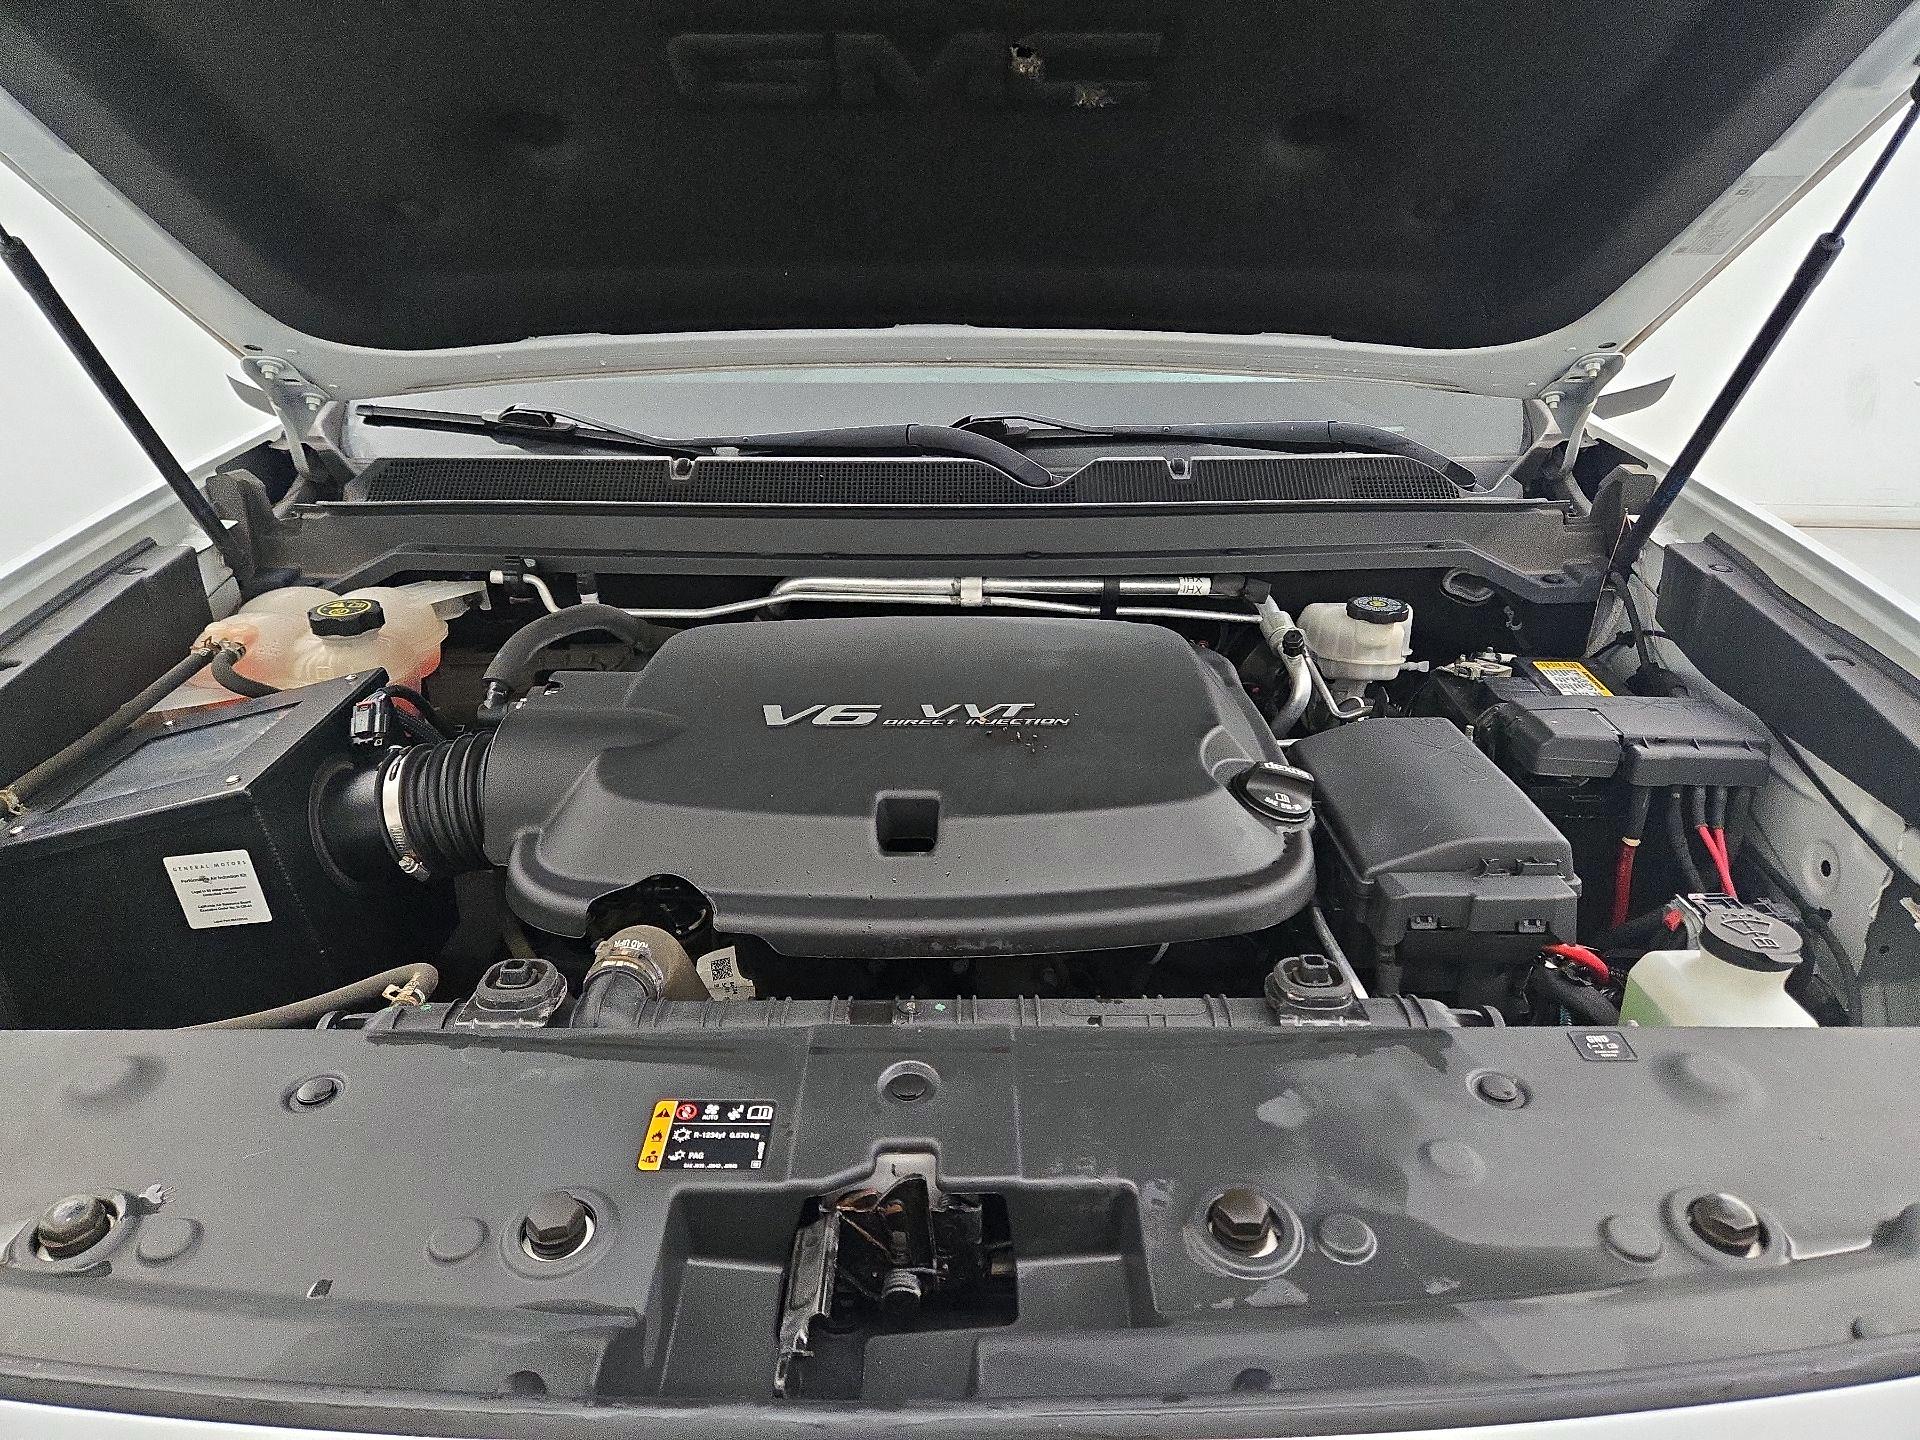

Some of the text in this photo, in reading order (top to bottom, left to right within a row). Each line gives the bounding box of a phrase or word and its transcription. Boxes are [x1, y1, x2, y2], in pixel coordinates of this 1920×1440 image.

[667, 32, 1163, 108] GMC
[762, 704, 882, 727] V6
[920, 703, 1036, 718] VVT
[882, 718, 1070, 727] DIRECT INJECTION
[693, 1131, 726, 1139] R-1234yf
[750, 1131, 760, 1140] kg
[688, 1151, 704, 1160] PAG
